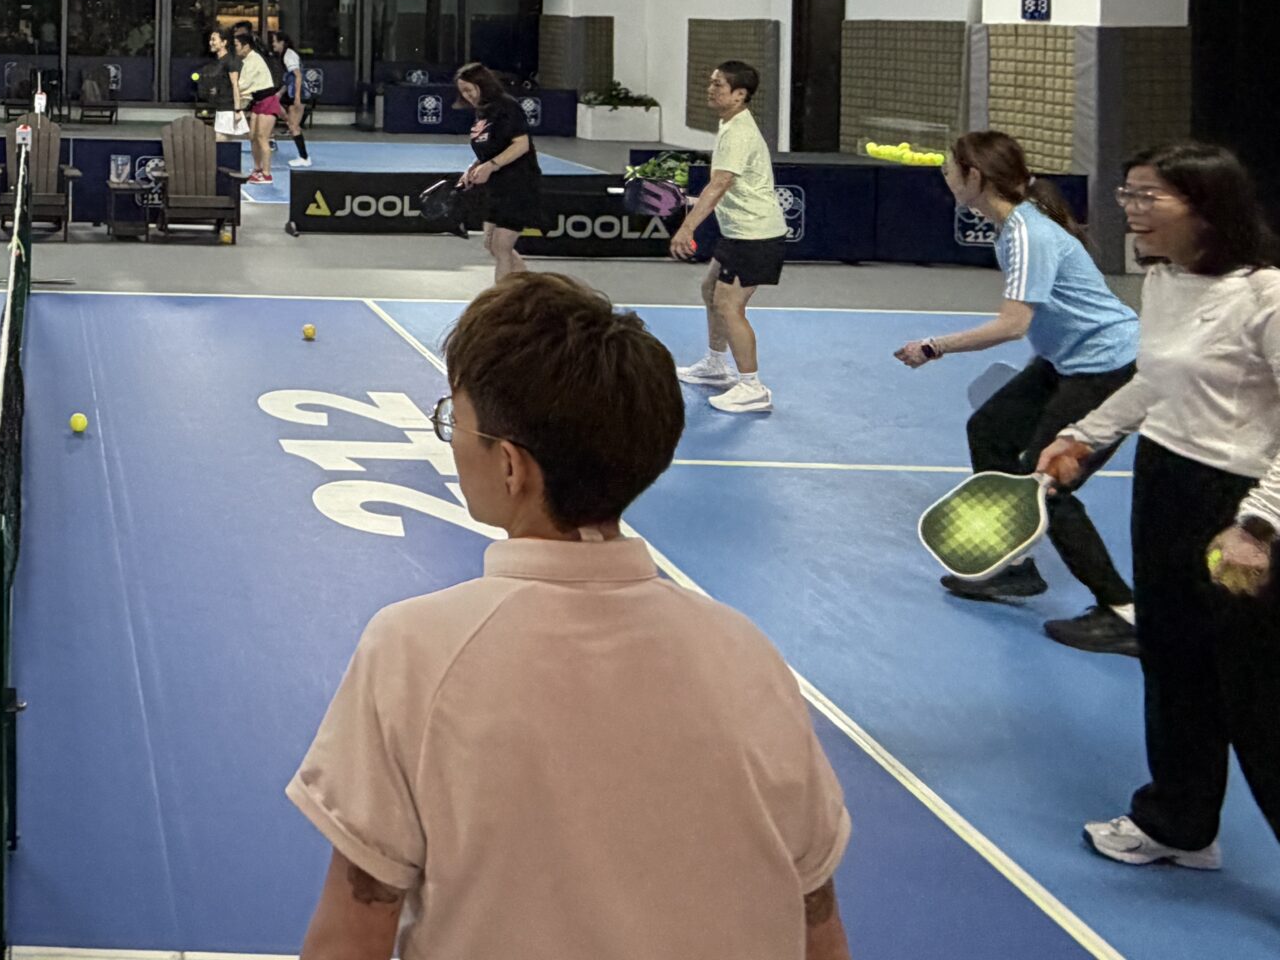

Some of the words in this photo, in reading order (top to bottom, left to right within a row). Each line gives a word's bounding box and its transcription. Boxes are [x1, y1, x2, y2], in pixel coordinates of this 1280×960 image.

[334, 195, 421, 217] JOOL
[546, 214, 670, 239] JOOLA
[965, 231, 995, 242] 212
[257, 389, 510, 540] 212
